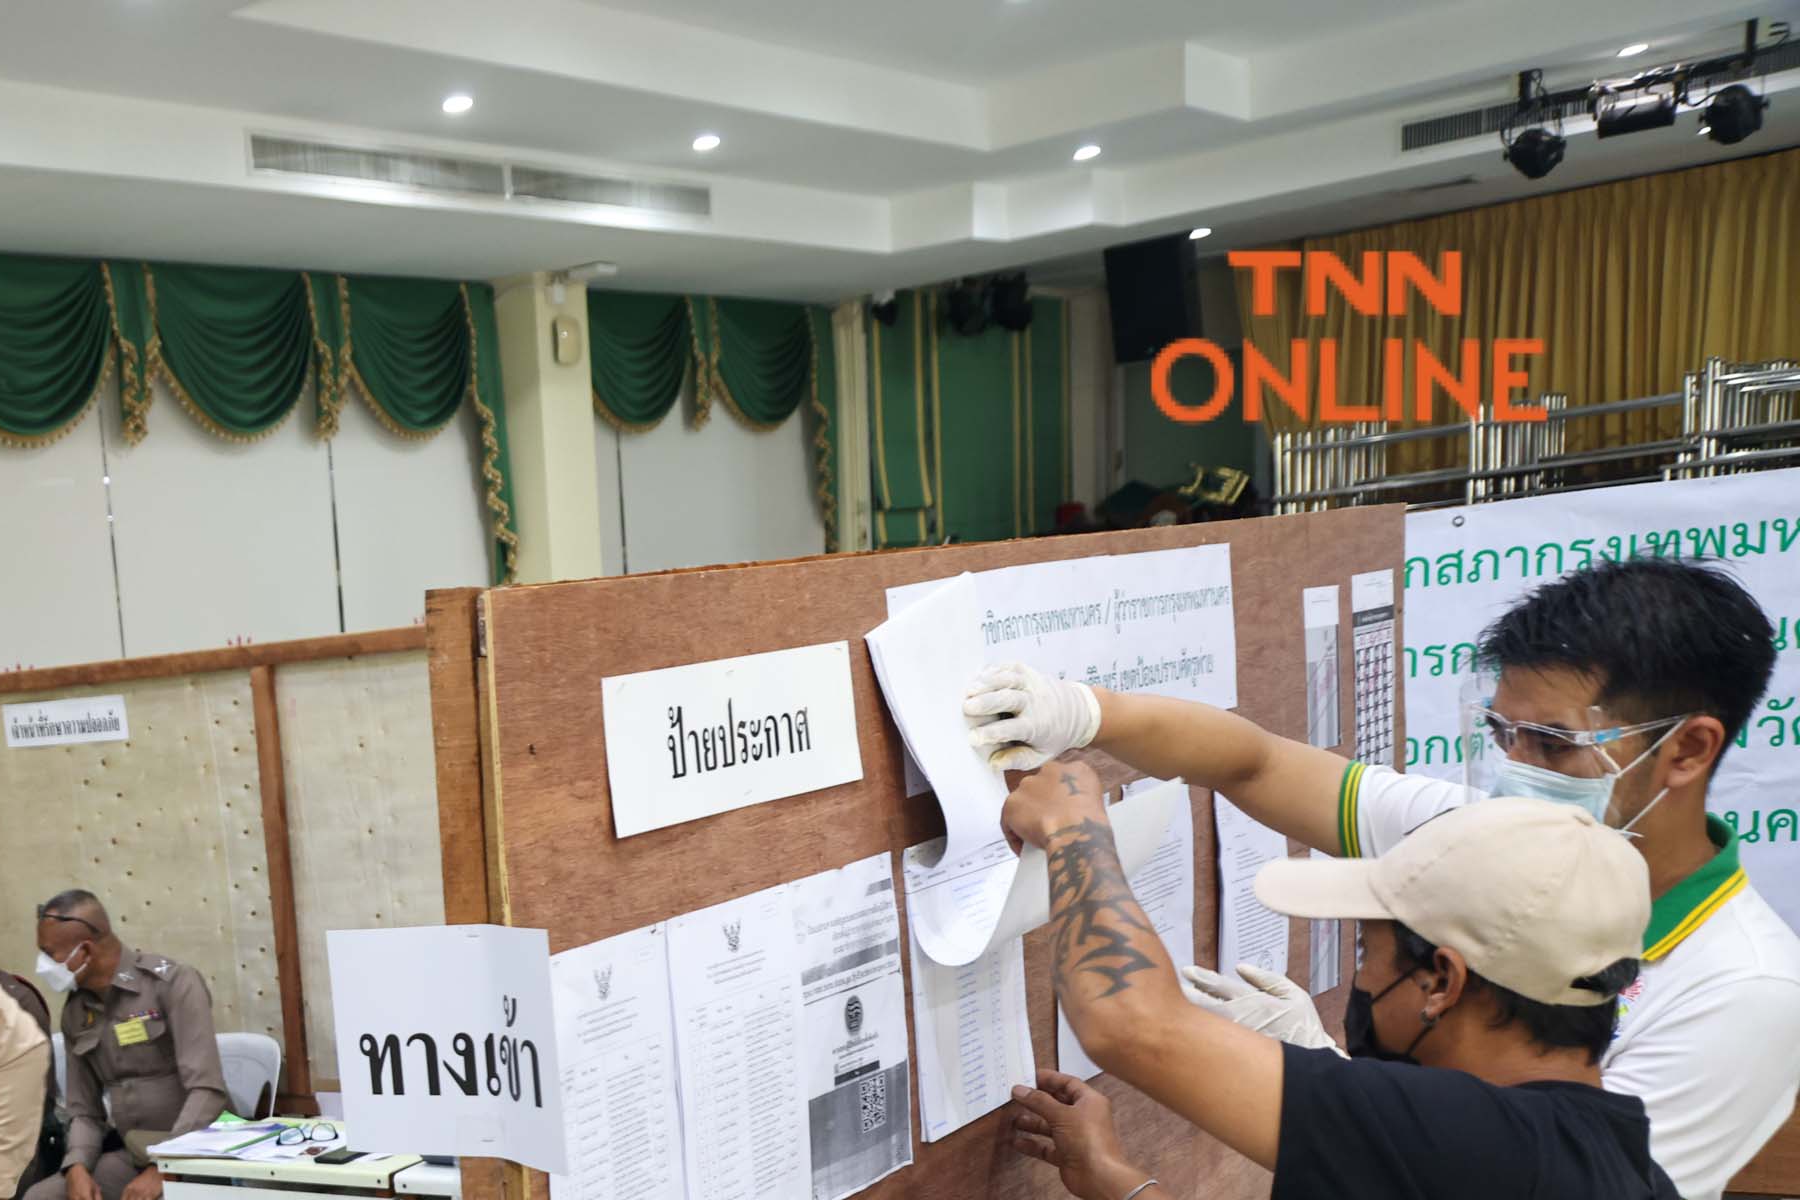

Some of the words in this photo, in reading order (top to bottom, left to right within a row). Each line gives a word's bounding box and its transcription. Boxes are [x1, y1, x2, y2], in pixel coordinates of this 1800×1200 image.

[667, 697, 811, 779] ป้ายประกาศ
[359, 994, 544, 1109] ทางเข้า
